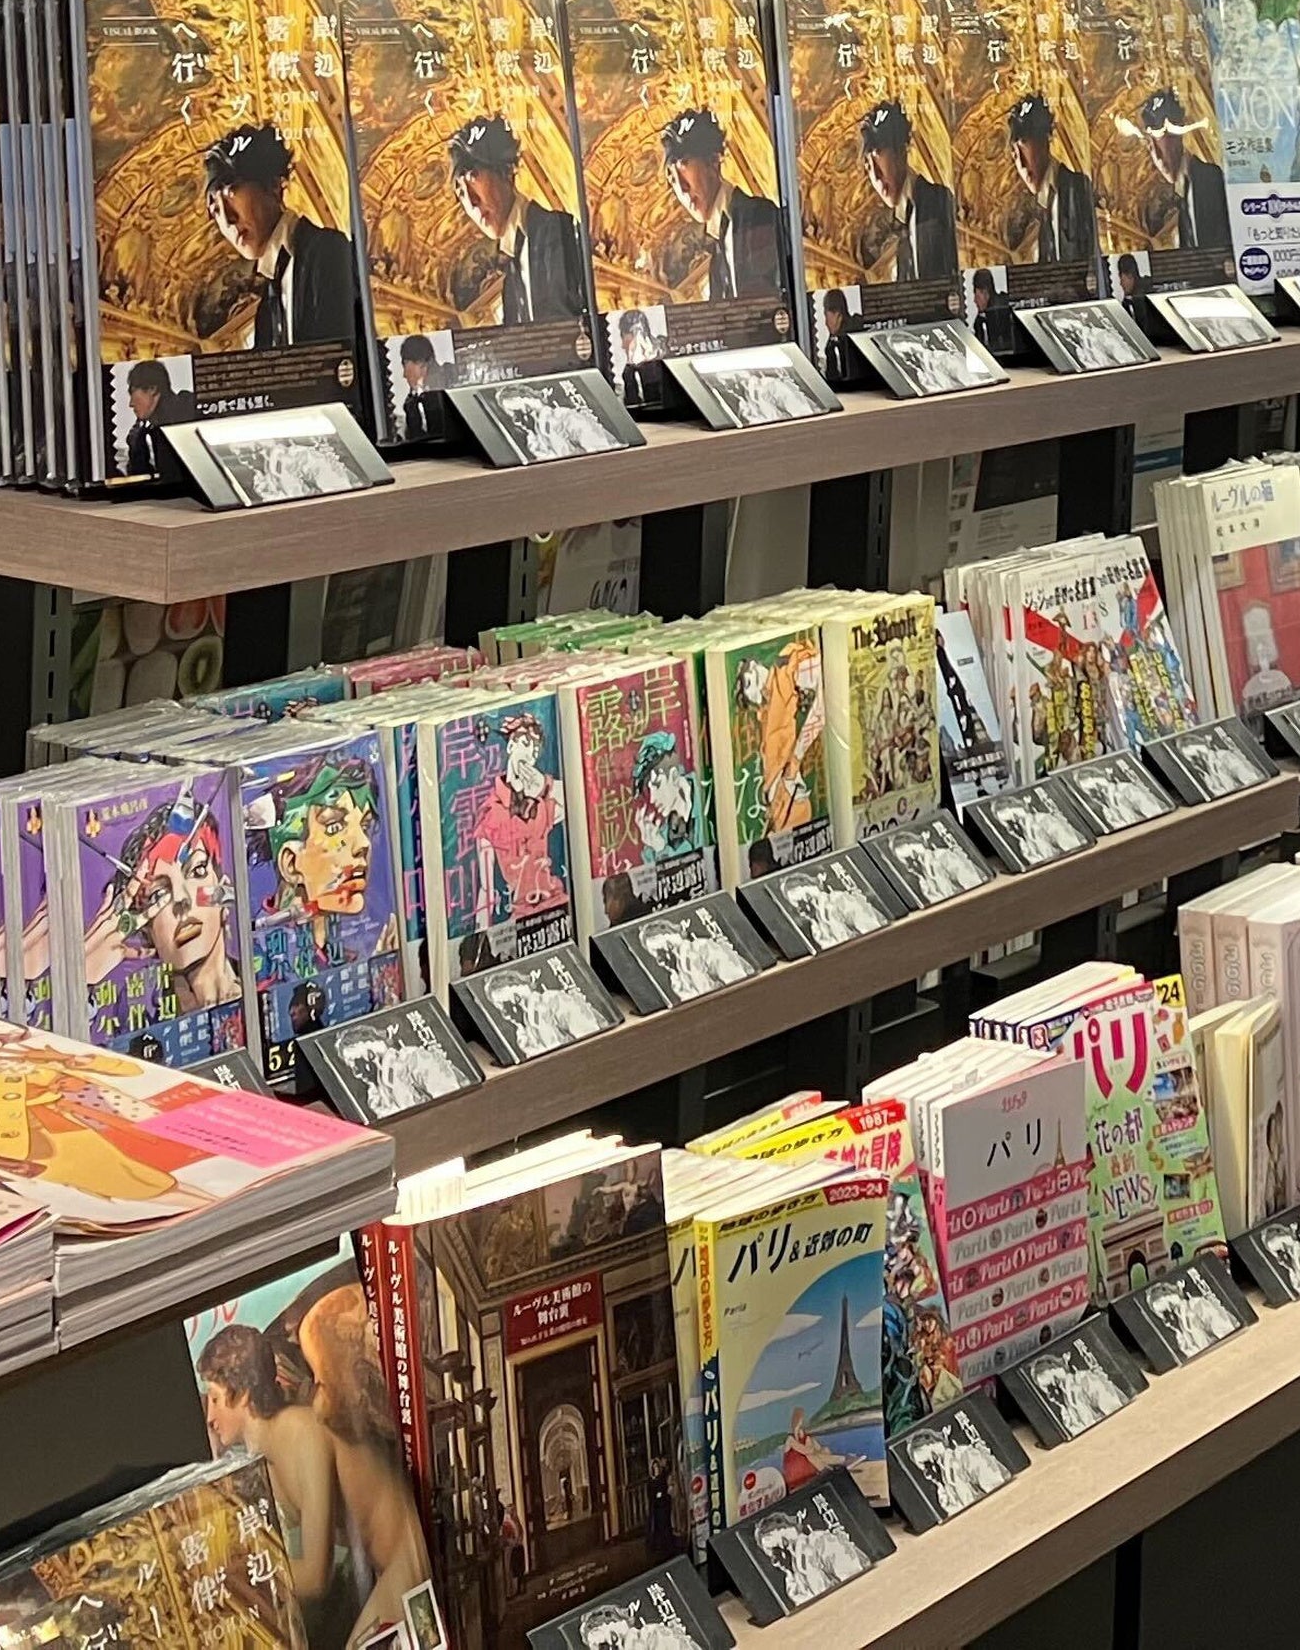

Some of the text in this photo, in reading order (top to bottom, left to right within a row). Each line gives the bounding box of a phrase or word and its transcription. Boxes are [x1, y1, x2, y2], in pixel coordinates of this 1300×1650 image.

[1211, 479, 1275, 510] ルーヴルの猫
[1073, 1012, 1148, 1099] パリ
[986, 1117, 1042, 1167] パリ
[1094, 1107, 1143, 1157] 花の都
[718, 1192, 821, 1232] 地球の歩き方
[829, 1183, 884, 1202] 2023-24
[511, 1281, 592, 1318] ルーヴル美術館の
